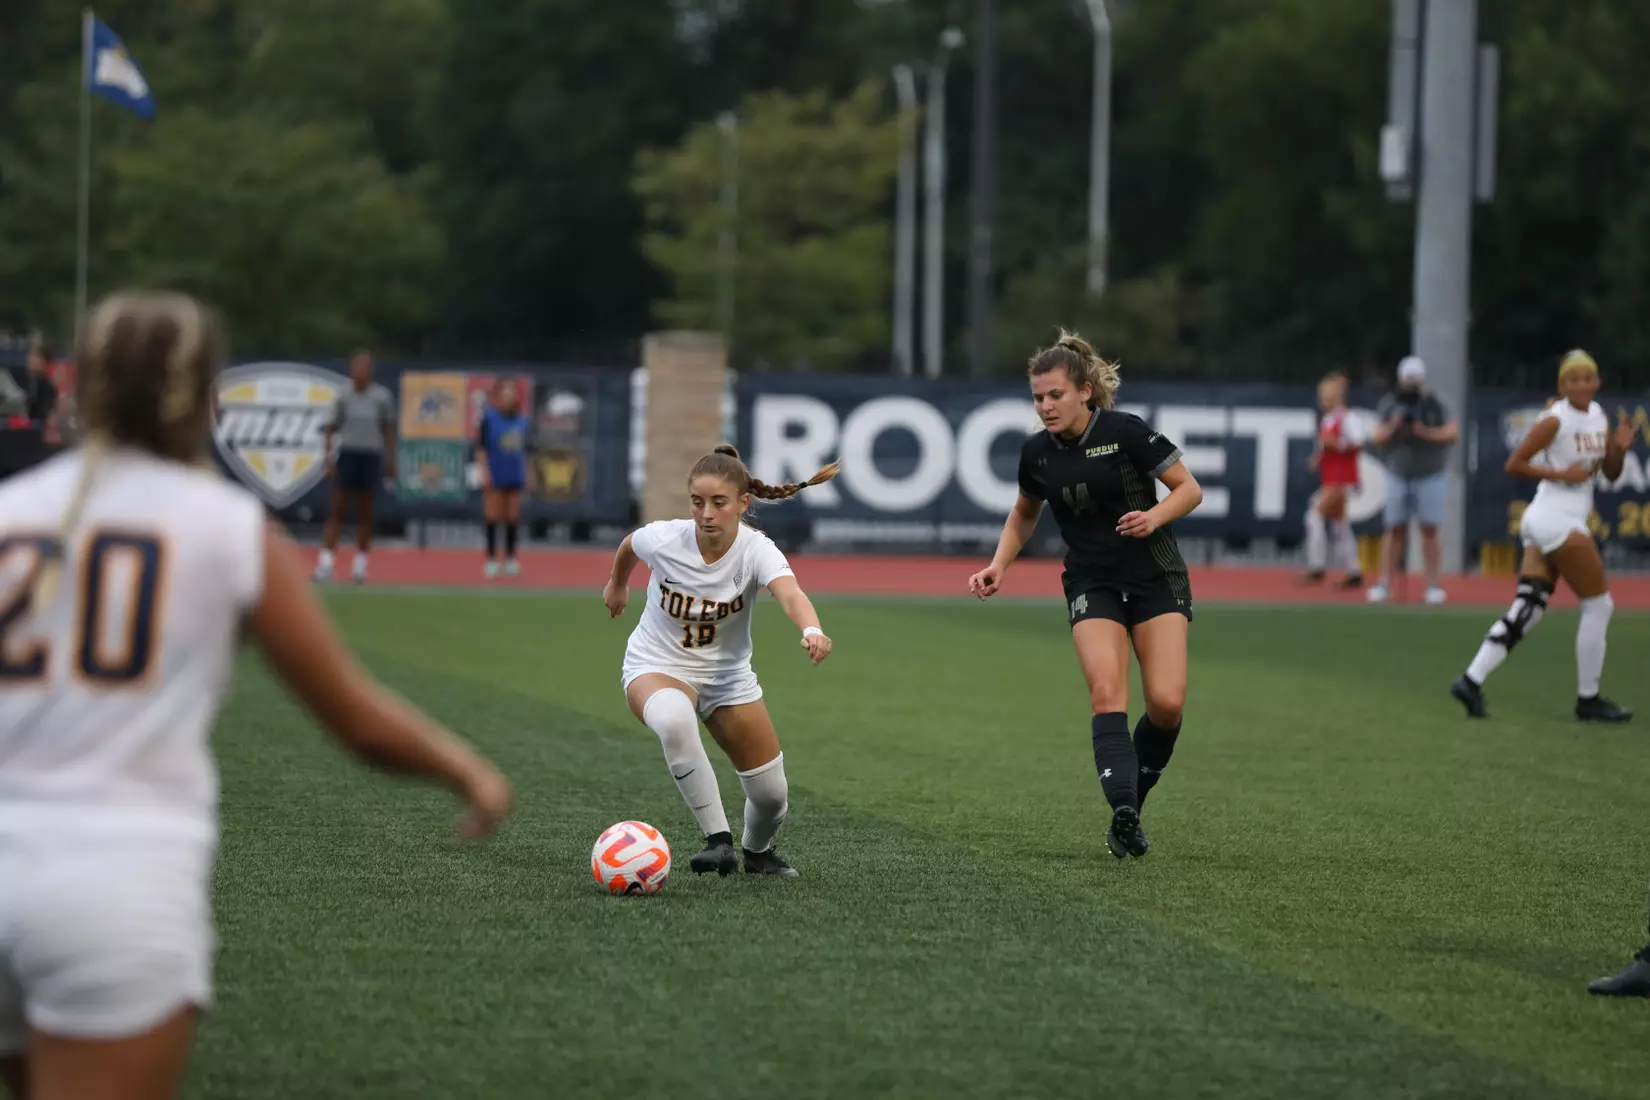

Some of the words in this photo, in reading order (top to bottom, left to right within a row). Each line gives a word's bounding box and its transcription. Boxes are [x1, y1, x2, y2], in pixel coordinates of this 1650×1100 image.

[753, 394, 1388, 525] ROCETS
[1085, 442, 1119, 455] PURDUE
[0, 524, 168, 692] 20
[659, 584, 744, 622] TOLEDO
[1070, 592, 1088, 619] 14
